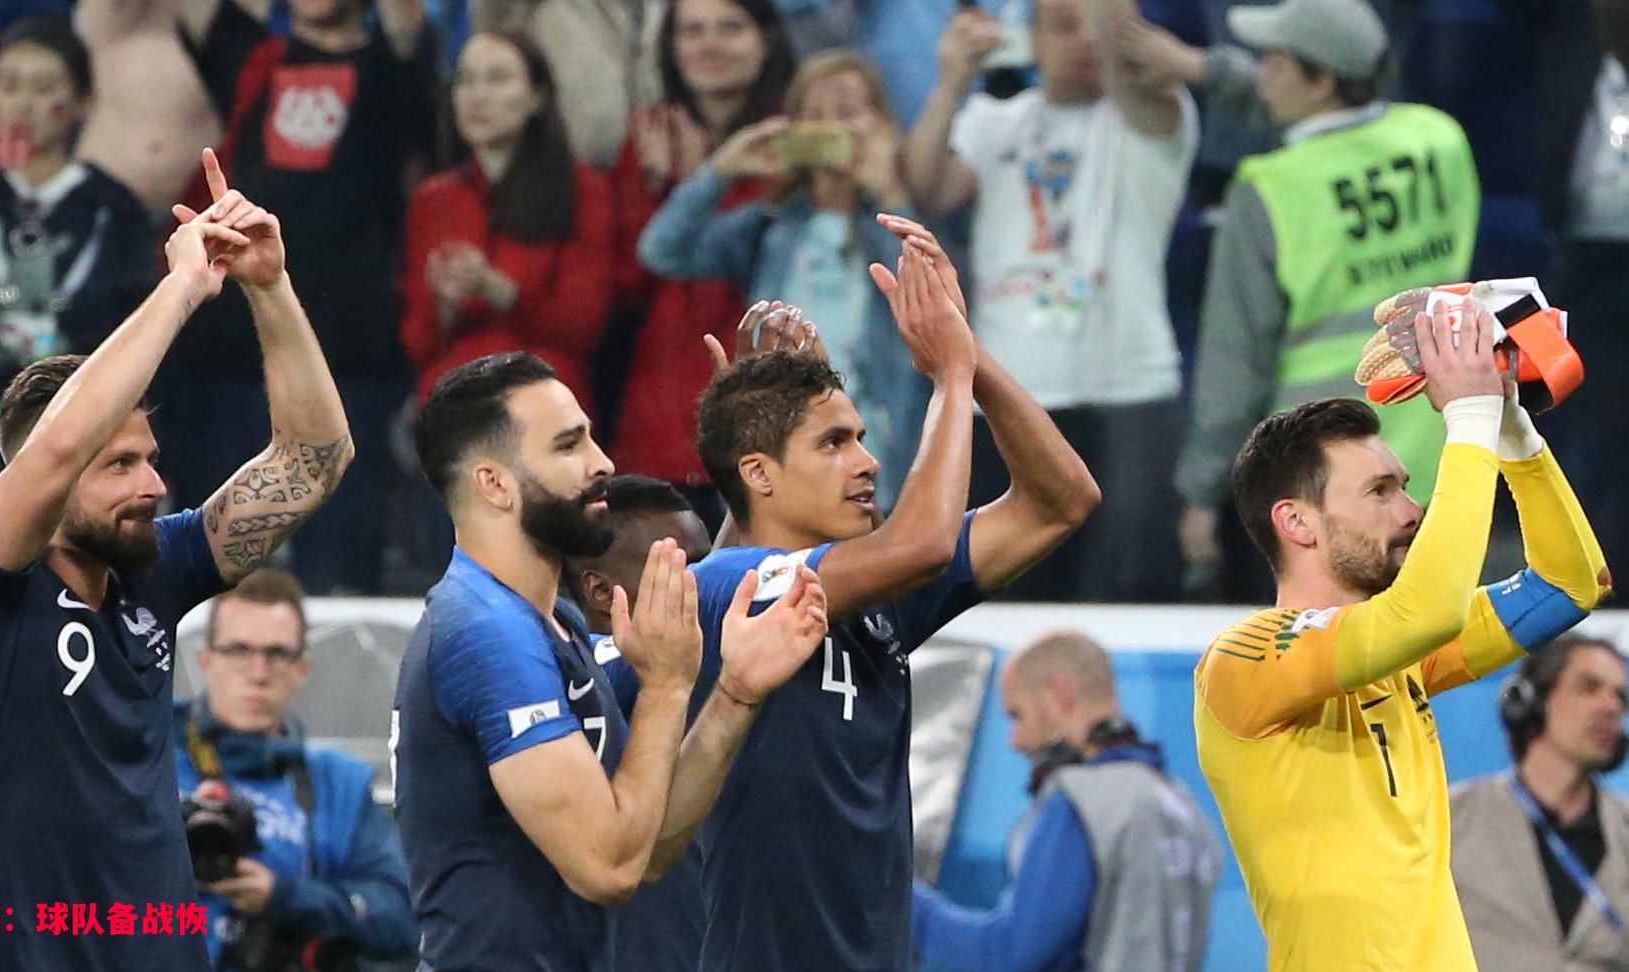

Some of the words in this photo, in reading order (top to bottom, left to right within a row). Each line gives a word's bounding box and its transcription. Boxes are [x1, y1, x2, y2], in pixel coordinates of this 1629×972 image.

[1333, 151, 1448, 239] 5571
[57, 621, 96, 696] 9
[821, 636, 858, 721] 4
[1369, 723, 1398, 798] 1
